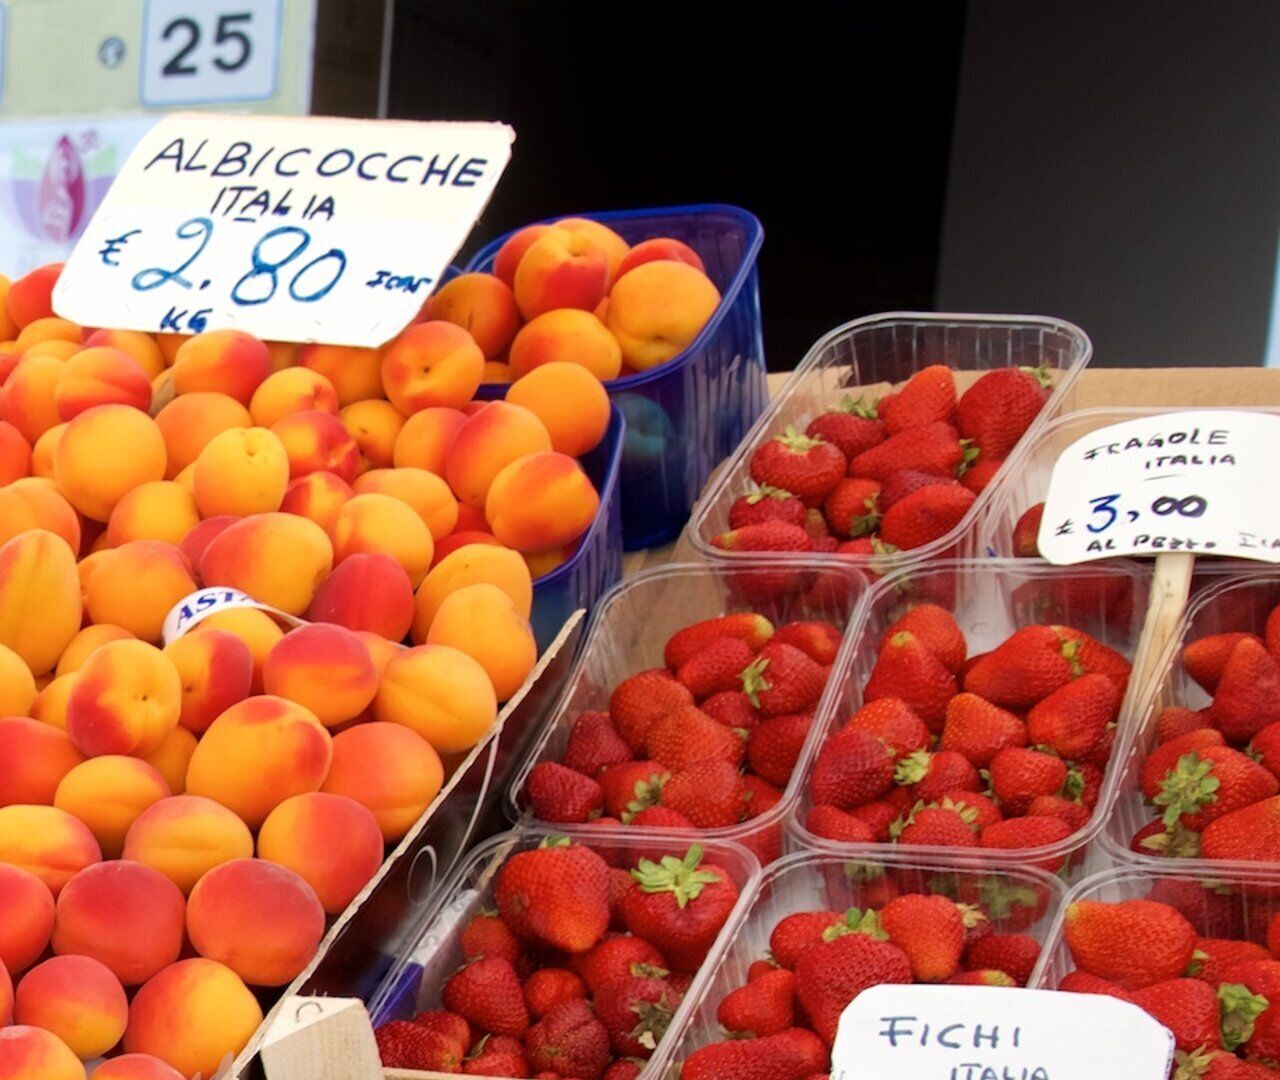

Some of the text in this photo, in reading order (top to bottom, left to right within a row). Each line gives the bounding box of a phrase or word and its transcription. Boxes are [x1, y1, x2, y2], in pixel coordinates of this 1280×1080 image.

[160, 13, 253, 78] 25
[144, 138, 488, 188] ALBICOCCHE
[211, 187, 336, 221] ITALIA
[132, 217, 347, 306] 2.80
[160, 306, 213, 332] KG
[1085, 428, 1231, 461] FRAGOLE
[1145, 455, 1237, 470] ITALIA
[1086, 538, 1117, 552] AL
[879, 1016, 1020, 1049] FICHI
